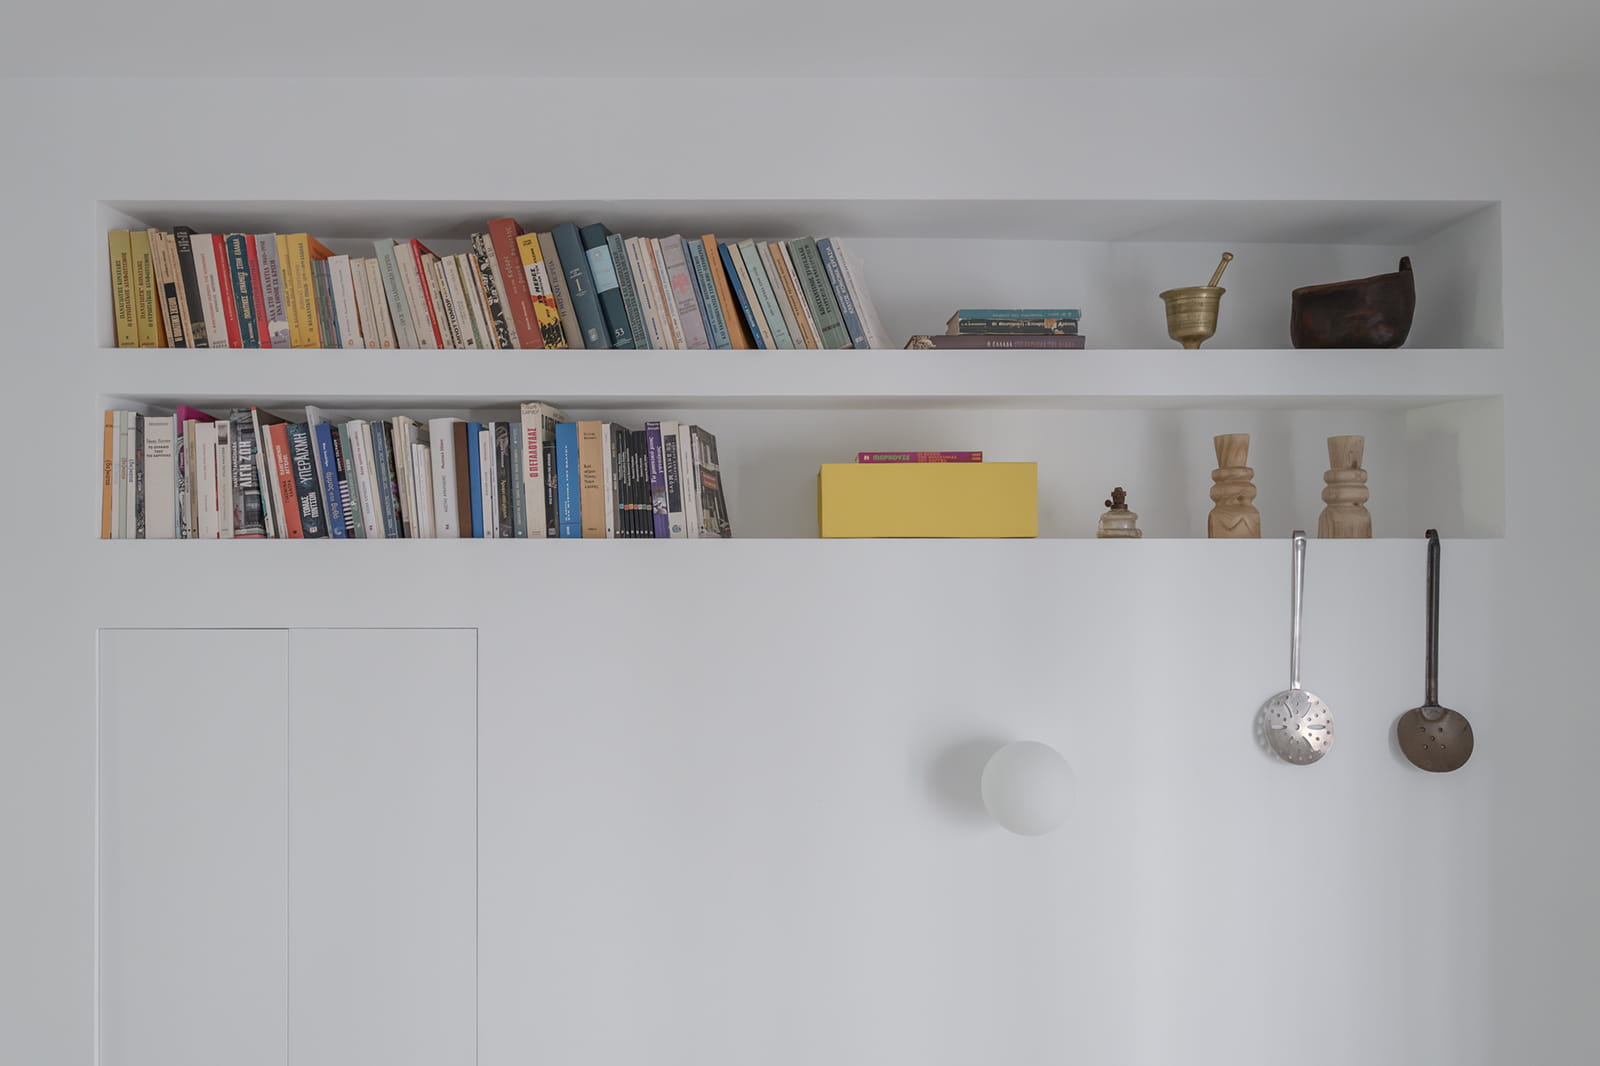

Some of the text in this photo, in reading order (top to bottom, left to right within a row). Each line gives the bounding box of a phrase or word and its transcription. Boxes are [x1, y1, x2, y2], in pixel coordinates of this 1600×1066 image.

[238, 441, 252, 488] ΛΙΓΗ ΖΩΗ
[293, 432, 313, 484] ΥΠΕΡΑΙΧΜΗ
[527, 428, 538, 471] ΠΕΤΑΛΟΥΔΑΣ
